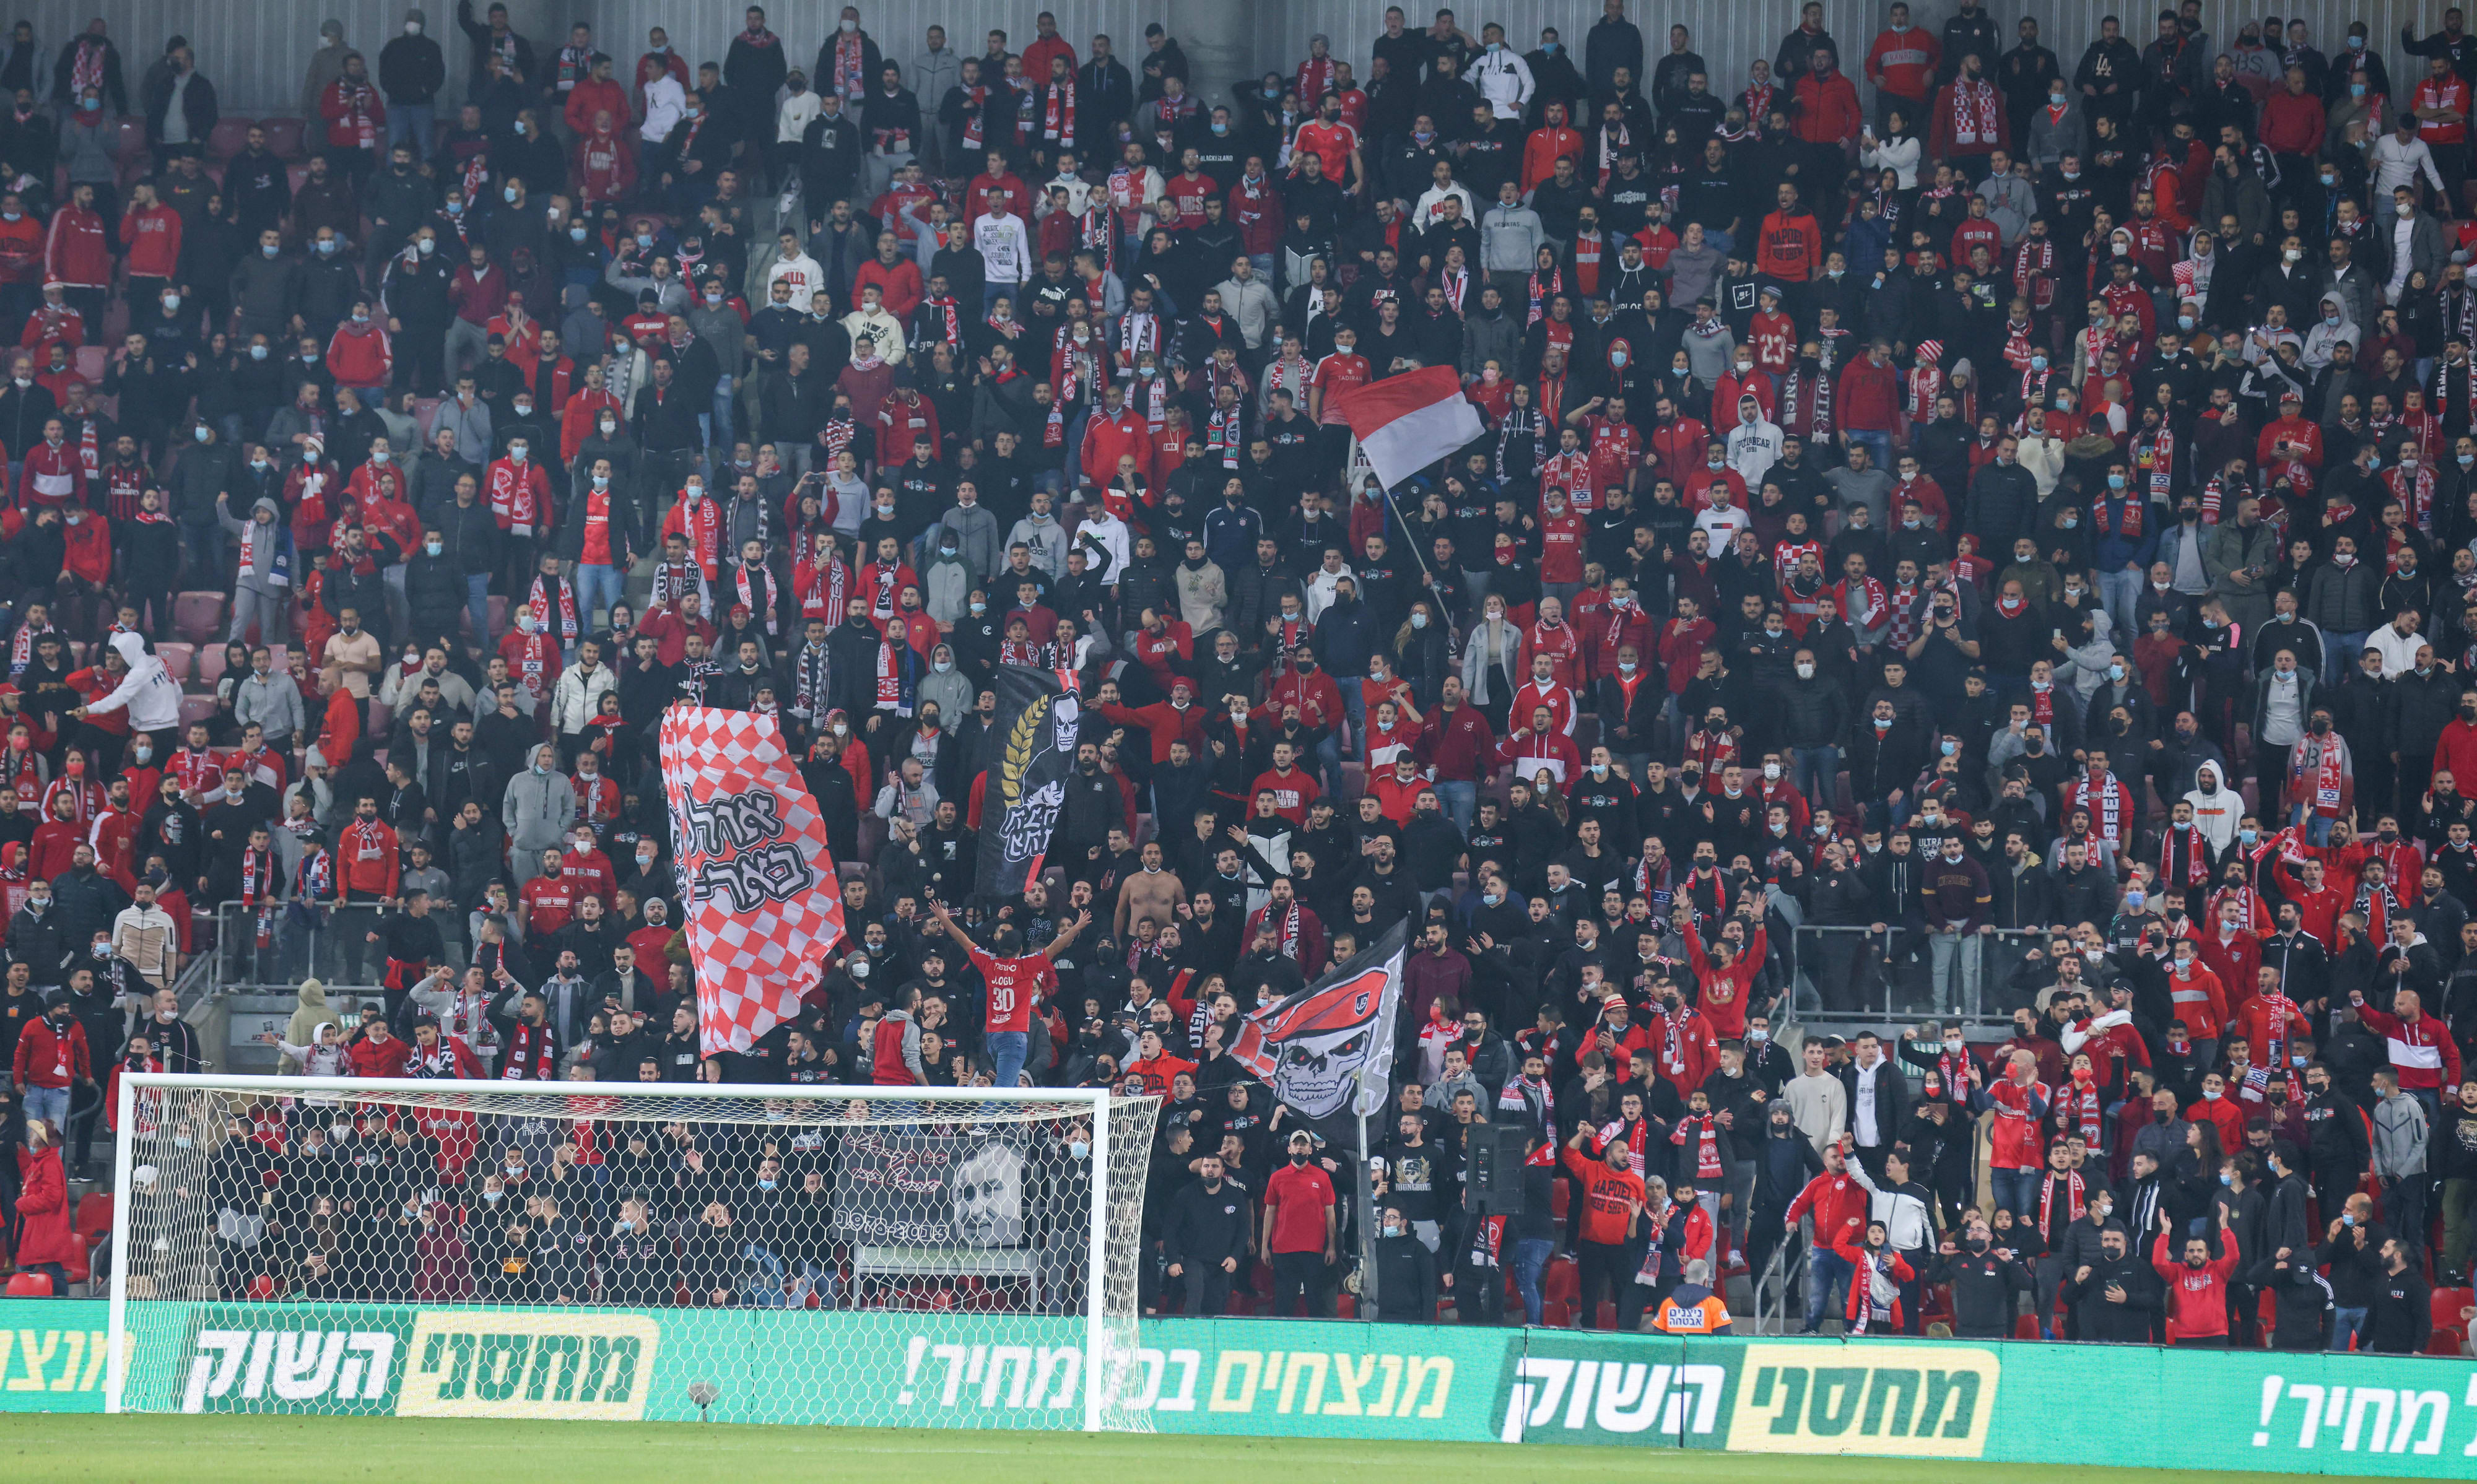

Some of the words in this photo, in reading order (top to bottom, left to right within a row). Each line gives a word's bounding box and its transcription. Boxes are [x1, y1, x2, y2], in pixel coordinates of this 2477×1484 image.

[2096, 53, 2111, 76] LA
[1040, 287, 1061, 302] PUMA
[1760, 334, 1787, 365] 23
[1918, 838, 1941, 847] ULTRA
[991, 976, 1014, 986] J.OGU
[993, 987, 1015, 1012] 30
[1395, 1182, 1432, 1192] YOUNGBOYS
[1594, 1179, 1631, 1202] HAPOEL
[835, 1210, 949, 1241] 1978-2013
[1669, 1308, 1702, 1317] ניצנים
[1669, 1317, 1702, 1326] אבטחה
[182, 1329, 397, 1415] השוק
[422, 1334, 642, 1404] מחסני
[897, 1335, 1082, 1409] מחיר!
[1208, 1350, 1454, 1419] מנצחים
[1501, 1356, 1726, 1443] השוק
[1751, 1366, 1982, 1438] מחסני
[2252, 1375, 2450, 1456] מחיר!
